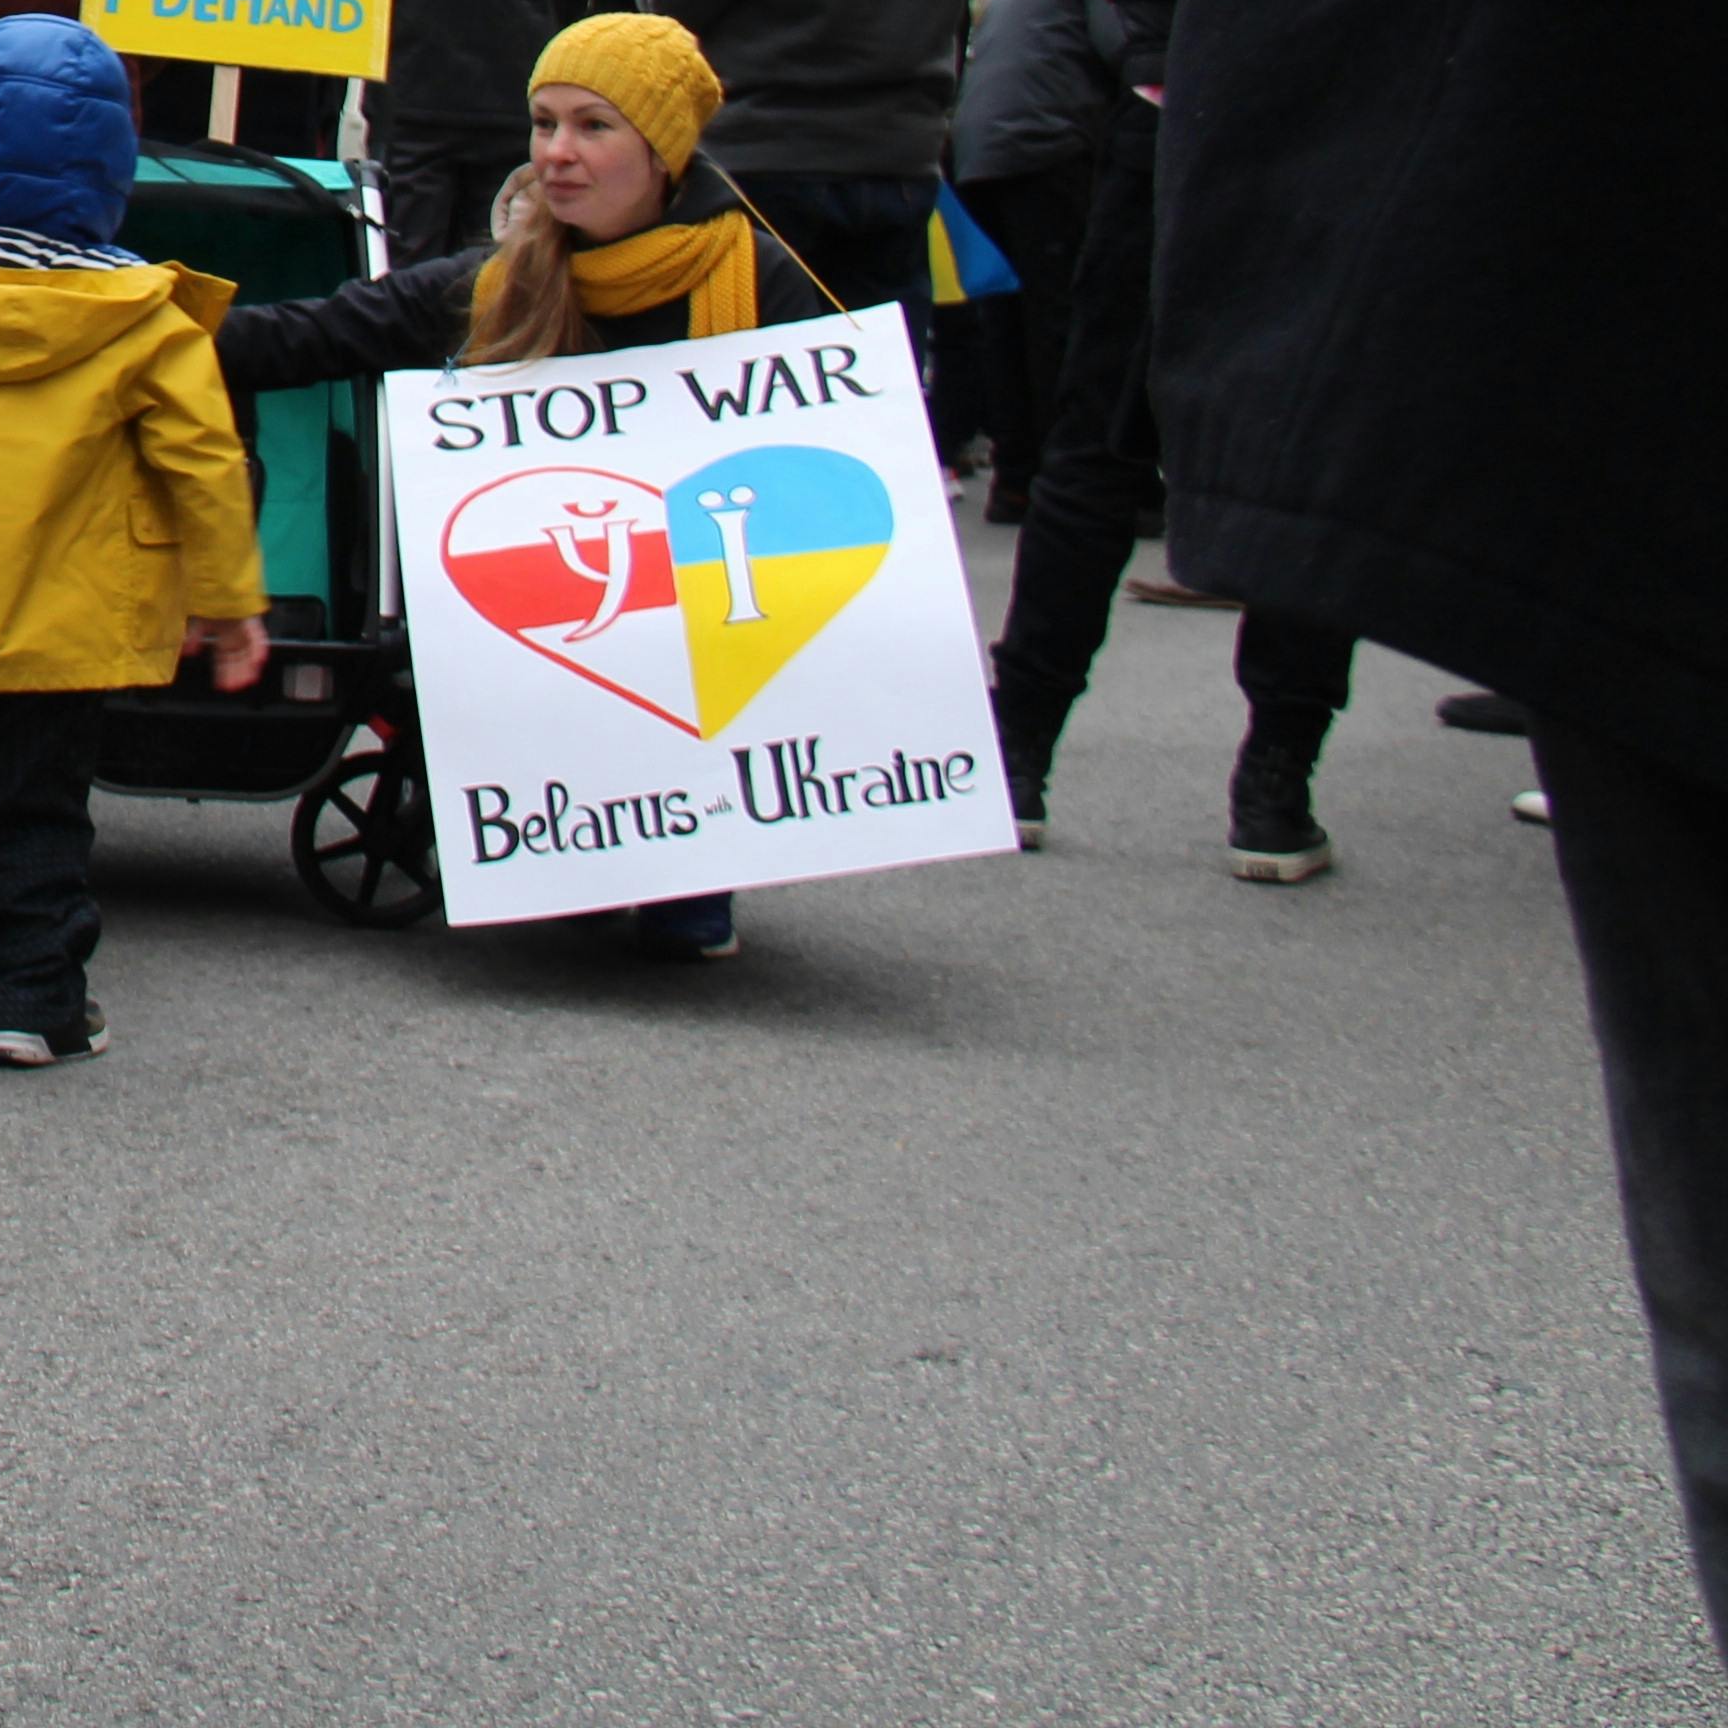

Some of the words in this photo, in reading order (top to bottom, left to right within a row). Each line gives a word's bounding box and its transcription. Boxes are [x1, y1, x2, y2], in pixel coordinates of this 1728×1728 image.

[428, 377, 648, 451] STOP
[677, 344, 883, 423] WAR
[463, 781, 699, 865] Belarus
